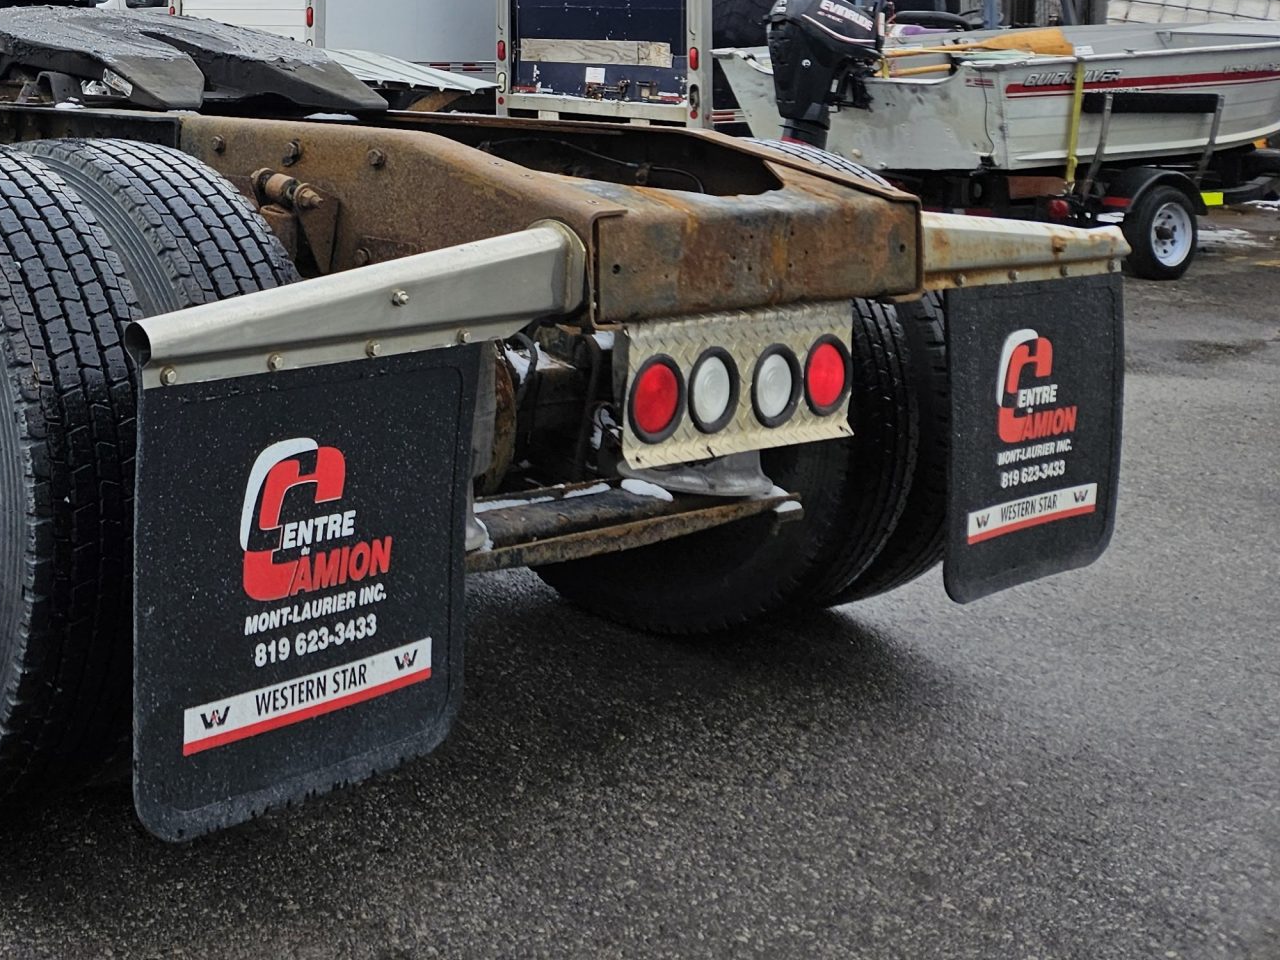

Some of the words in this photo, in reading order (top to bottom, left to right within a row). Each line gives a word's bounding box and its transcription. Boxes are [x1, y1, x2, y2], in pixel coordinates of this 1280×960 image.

[820, 0, 873, 31] EVINRUDE
[997, 442, 1055, 466] MONT-LAURIER
[1056, 439, 1073, 453] INC.
[1000, 469, 1020, 489] 819
[1021, 460, 1066, 484] 623-3433
[1000, 499, 1037, 523] WESTERN
[1038, 494, 1058, 513] STAR
[244, 590, 356, 636] MONT-LAURIER
[358, 582, 387, 606] INC.
[254, 637, 291, 668] 819
[295, 613, 378, 657] 623-3433
[255, 674, 327, 717] WESTERN
[332, 663, 368, 694] STAR
